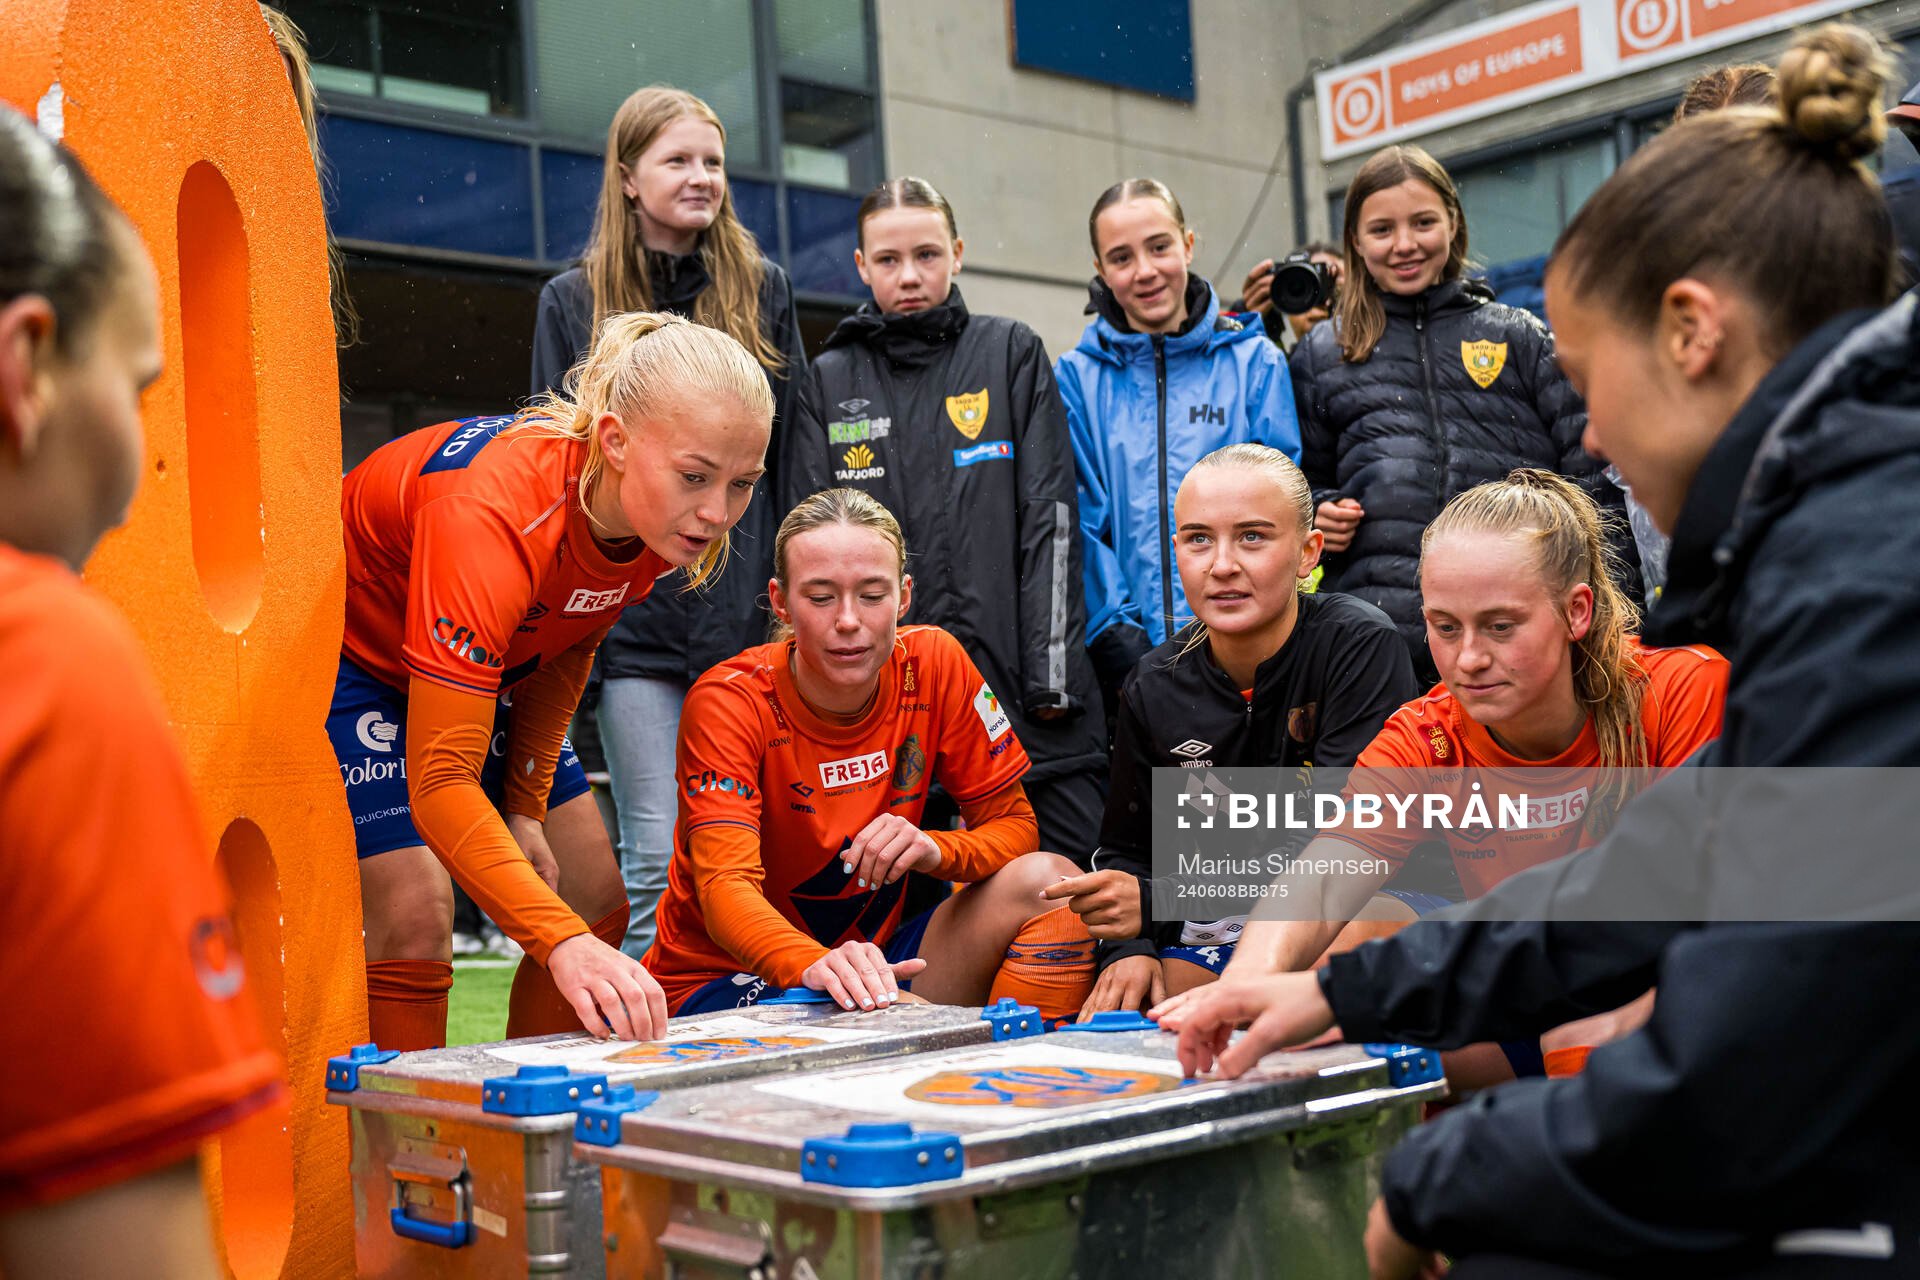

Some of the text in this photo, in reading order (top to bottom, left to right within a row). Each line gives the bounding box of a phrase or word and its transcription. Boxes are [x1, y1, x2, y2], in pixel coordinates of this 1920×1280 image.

[1402, 35, 1565, 102] BOYS OF EUROPE
[835, 466, 885, 480] TAFJORD
[823, 755, 884, 784] FREJA
[1180, 758, 1213, 768] umbro
